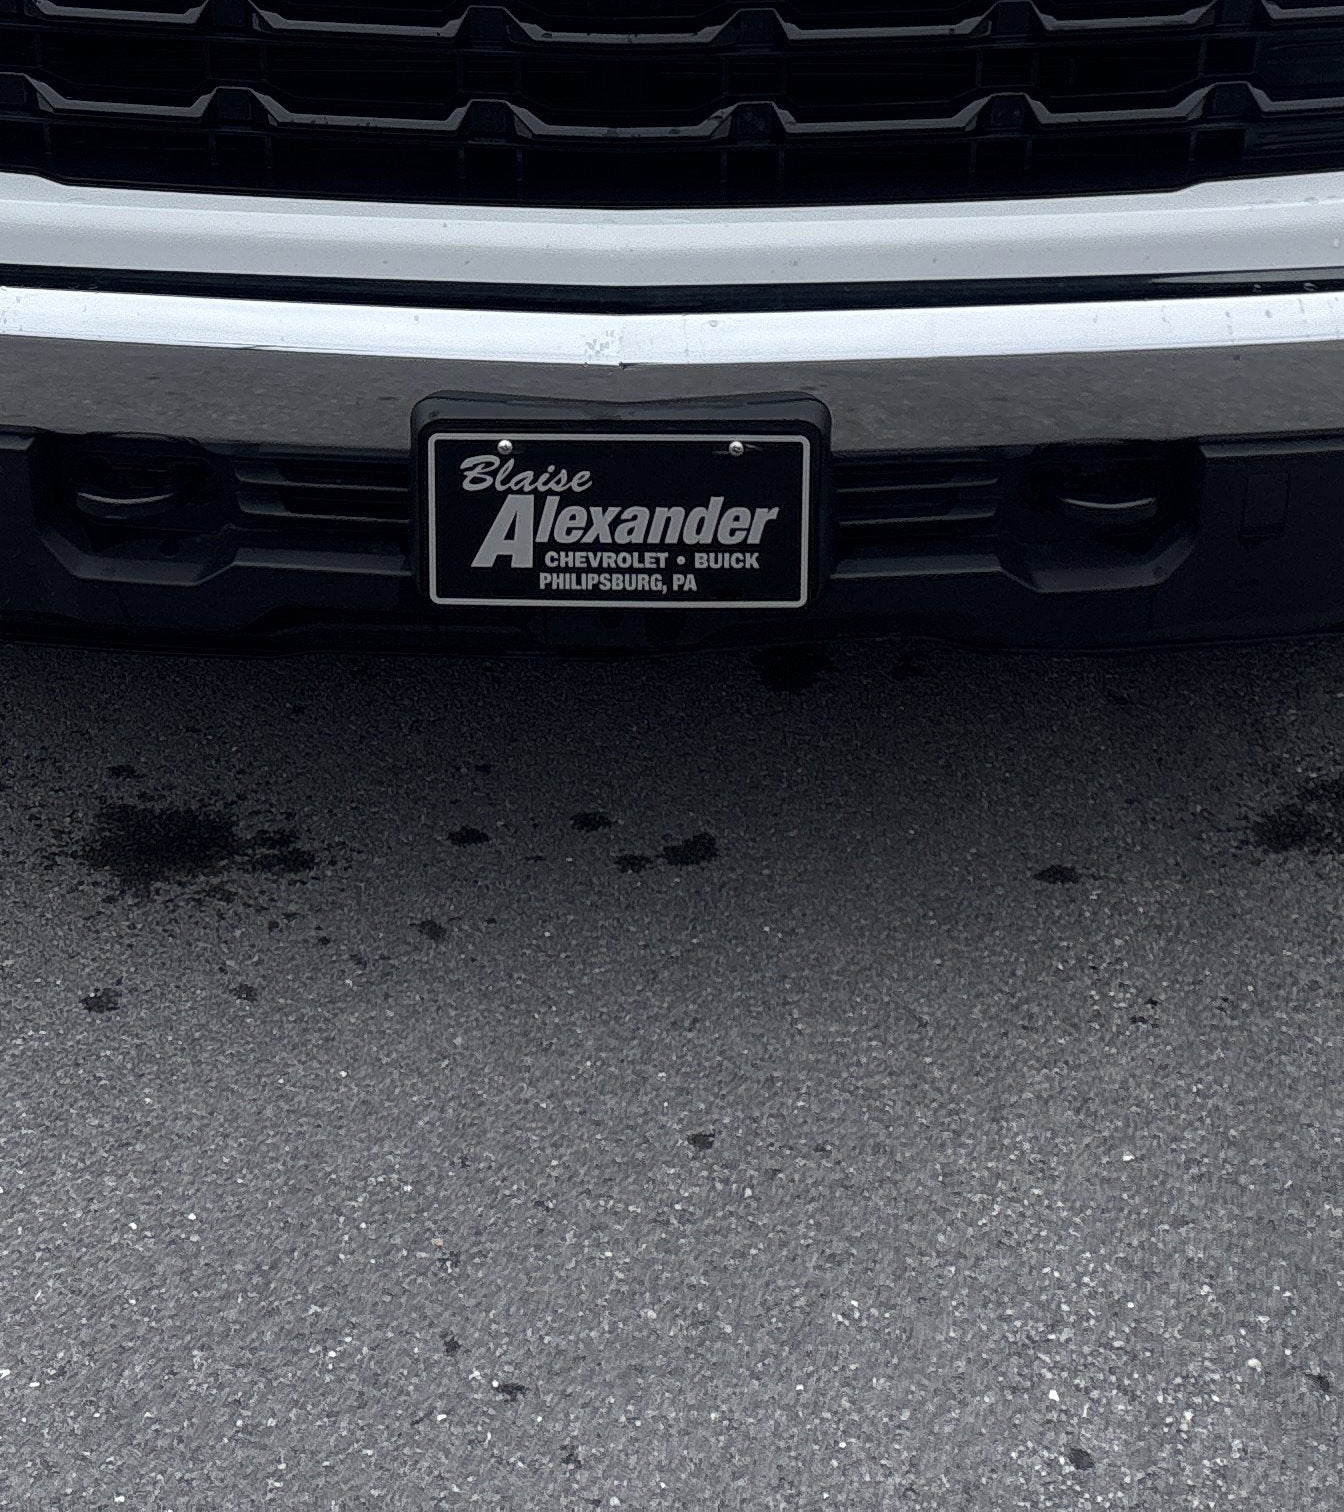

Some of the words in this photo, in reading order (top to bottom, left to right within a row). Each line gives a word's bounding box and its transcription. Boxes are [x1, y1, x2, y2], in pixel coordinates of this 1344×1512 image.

[460, 454, 593, 493] Blaise
[471, 494, 780, 568] Alexander
[545, 551, 669, 569] CHEVROLET
[694, 552, 760, 569] BUICK
[539, 572, 668, 595] PHILIPSBURG,
[673, 573, 698, 592] PA
